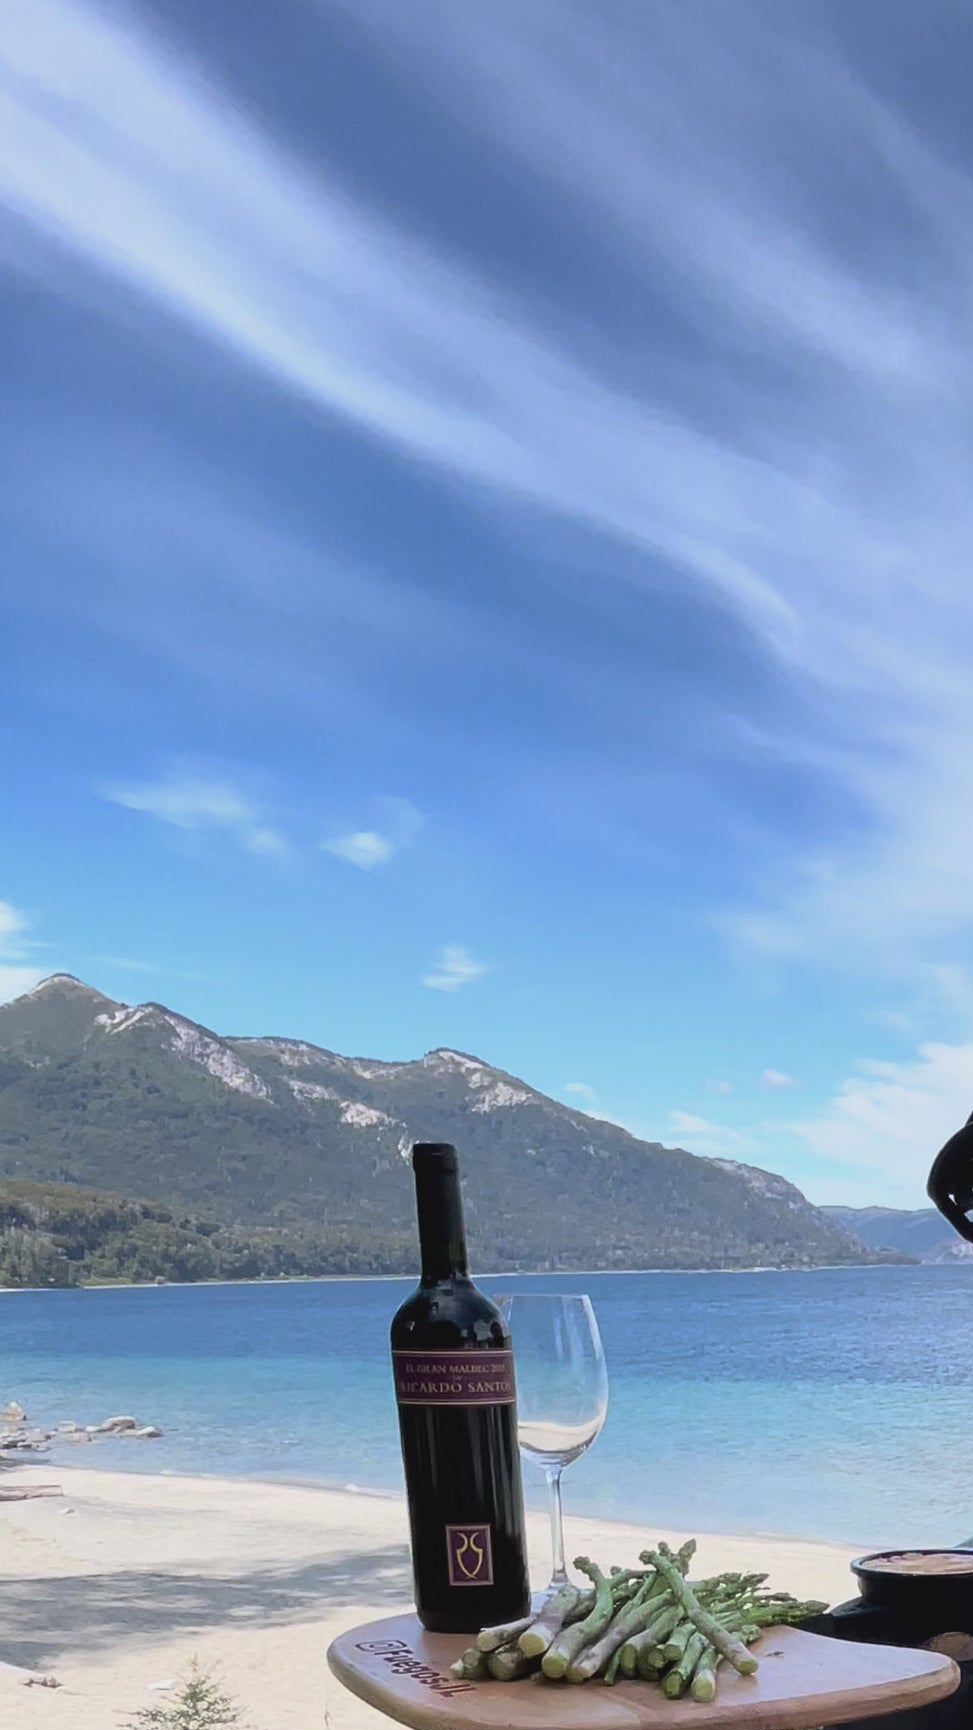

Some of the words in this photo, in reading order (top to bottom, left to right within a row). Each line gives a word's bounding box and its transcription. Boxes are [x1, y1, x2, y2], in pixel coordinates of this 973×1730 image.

[416, 1363, 447, 1373] GRAN
[449, 1364, 489, 1373] MALBEC
[400, 1382, 463, 1393] RICARDO
